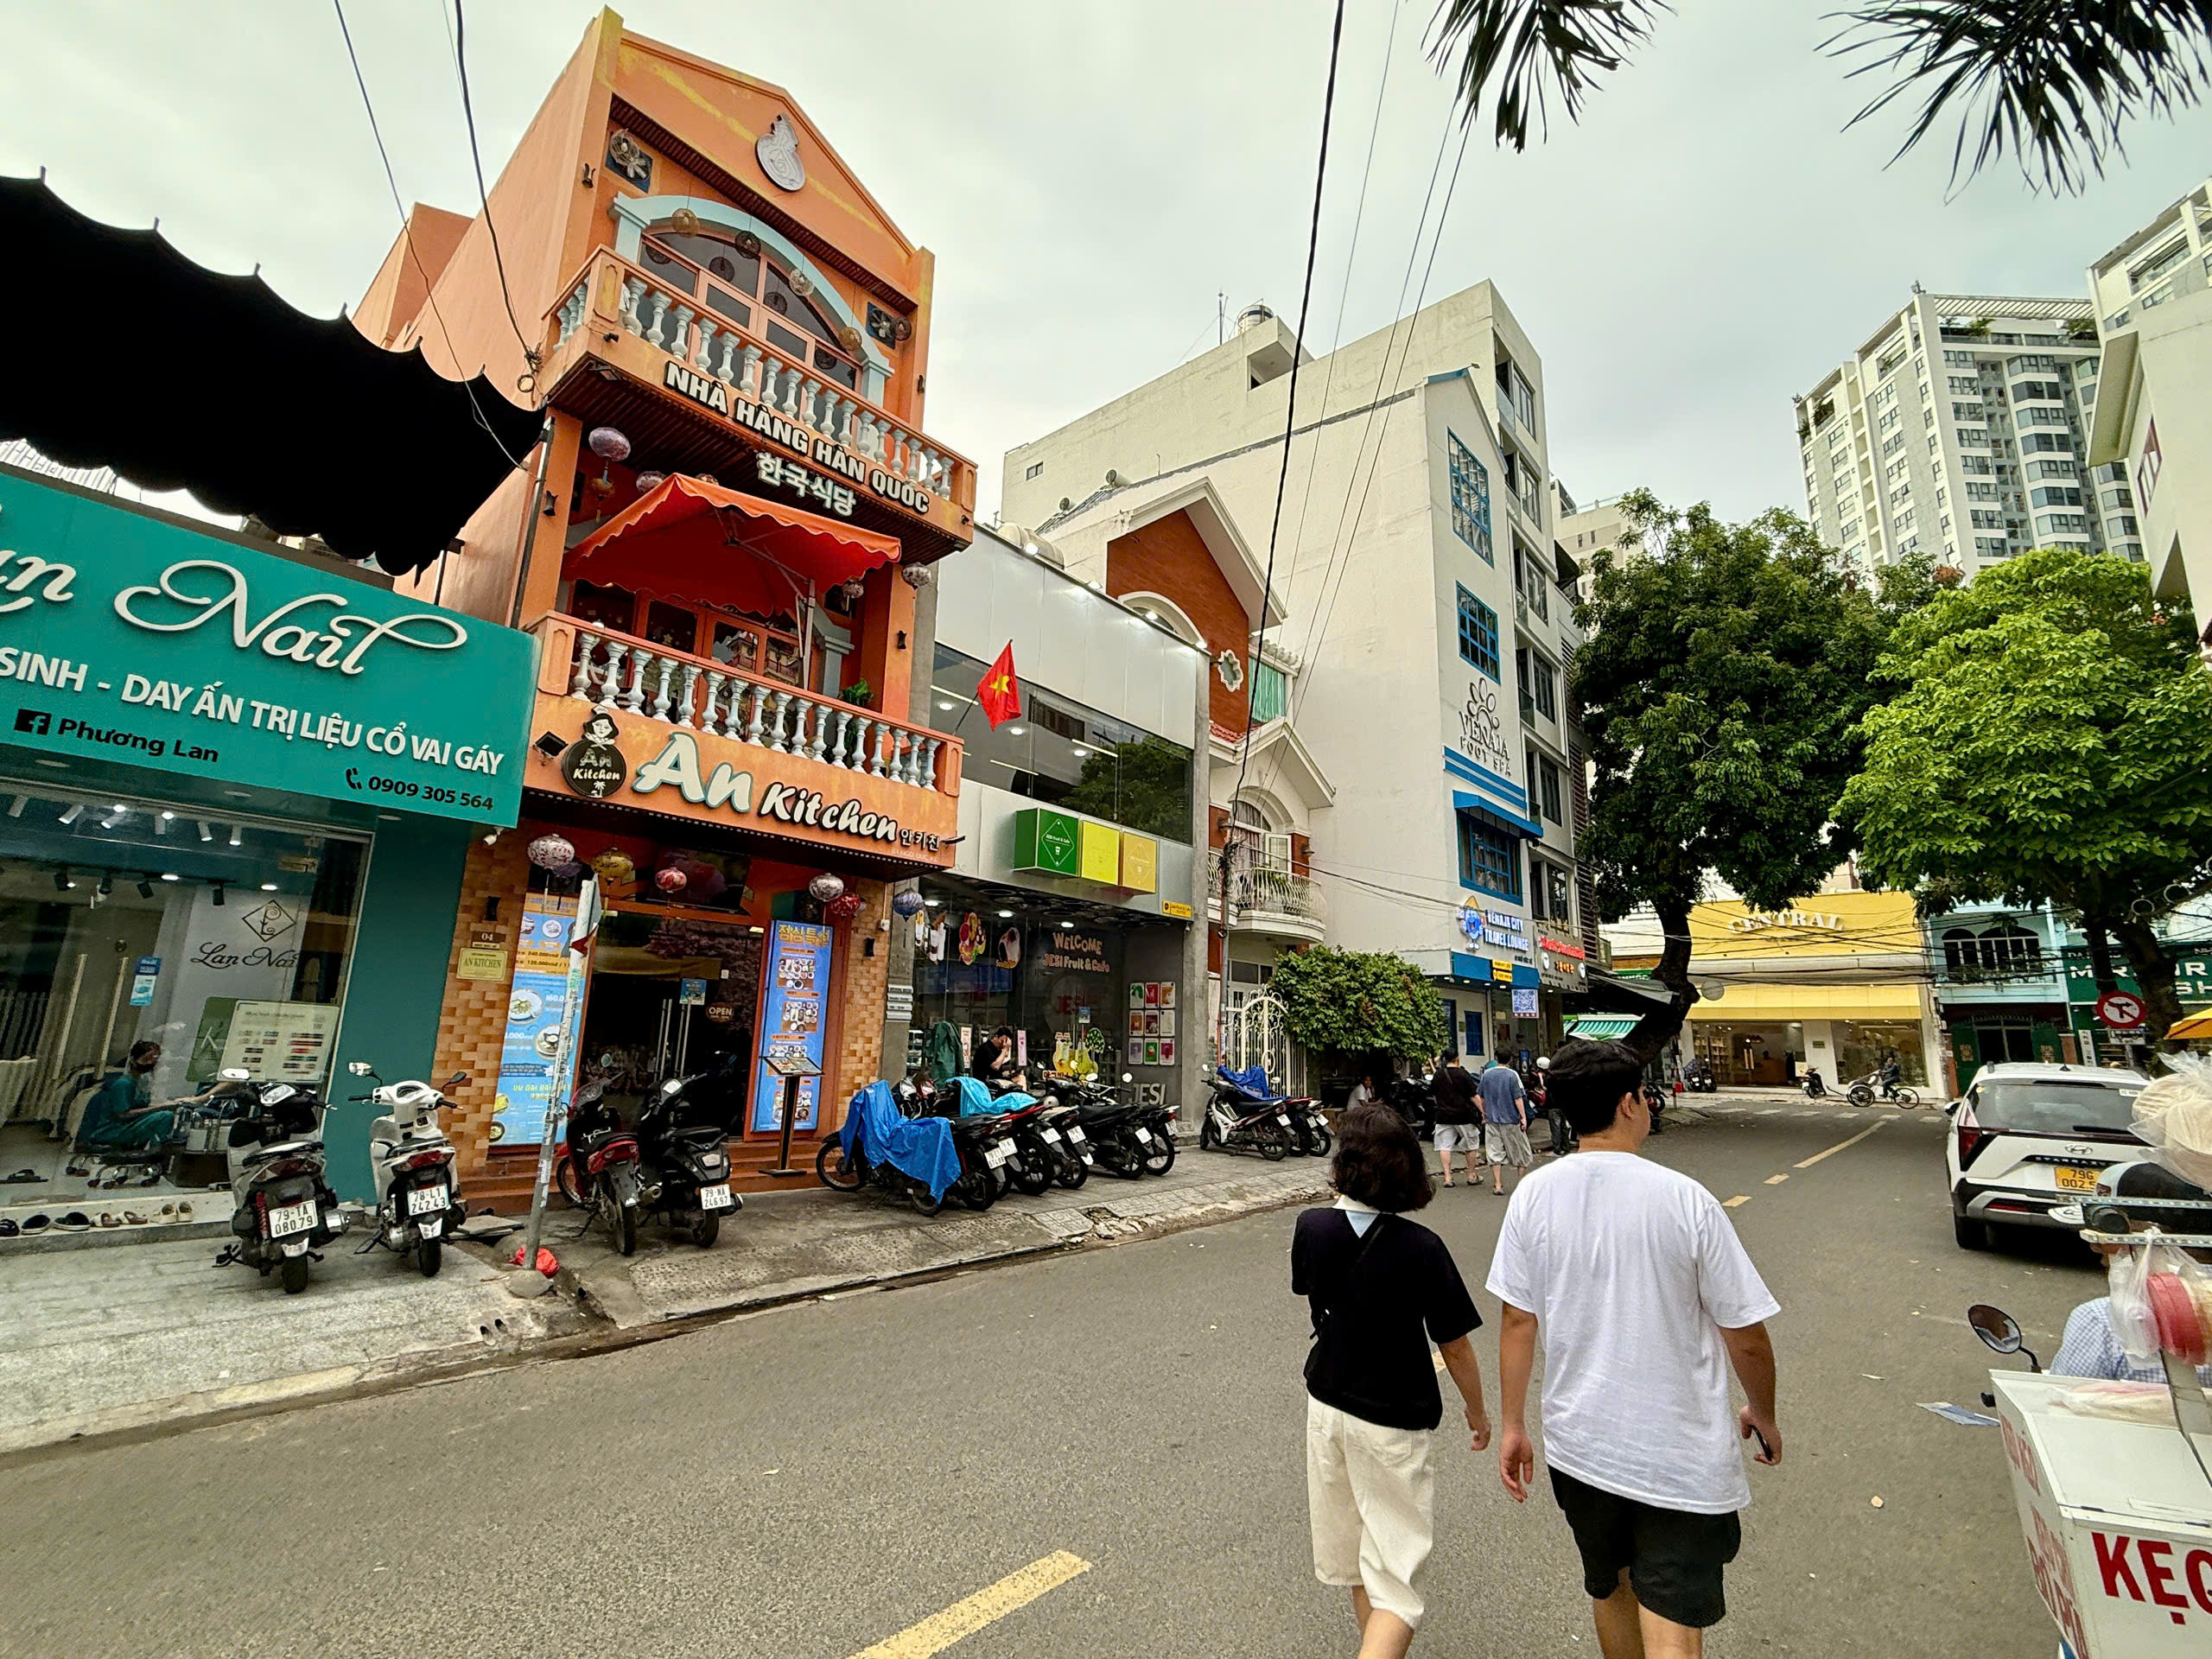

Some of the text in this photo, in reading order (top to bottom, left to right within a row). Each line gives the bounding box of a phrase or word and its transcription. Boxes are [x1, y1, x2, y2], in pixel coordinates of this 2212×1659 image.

[664, 360, 728, 416] NHÀ
[734, 397, 810, 457] HÀNG
[814, 438, 867, 484] HÀN
[756, 450, 856, 518] 한국식당
[113, 559, 467, 675] Nail
[0, 647, 88, 692] SINH
[121, 674, 194, 711] DAY
[192, 681, 245, 724] ẤN
[250, 700, 298, 741] TRỊ
[300, 712, 363, 749] LIỆU
[365, 721, 407, 756] CỔ
[410, 734, 452, 766] VAI
[454, 744, 505, 775] GÁY
[57, 718, 165, 756] Phương
[173, 740, 219, 762] Lan
[573, 768, 620, 780] Kitchen
[368, 776, 493, 810] 0909 305 564
[631, 732, 899, 843] An Kitchen
[899, 829, 940, 852] 안키친
[1510, 917, 1523, 932] CITY
[1728, 912, 1847, 934] CENTRAL
[1507, 934, 1529, 951] LOUNGE
[191, 942, 300, 969] Lan Nai
[1043, 953, 1110, 973] JESI Fruit & Cafe
[709, 1007, 733, 1015] OPEN
[1128, 1083, 1167, 1107] JESI
[2062, 1178, 2097, 1190] 002.5
[2070, 1169, 2094, 1180] 79G
[414, 1186, 442, 1202] 78-L1
[276, 1205, 309, 1223] 79-TA
[411, 1197, 447, 1214] 242.43
[275, 1216, 314, 1235] 080.79
